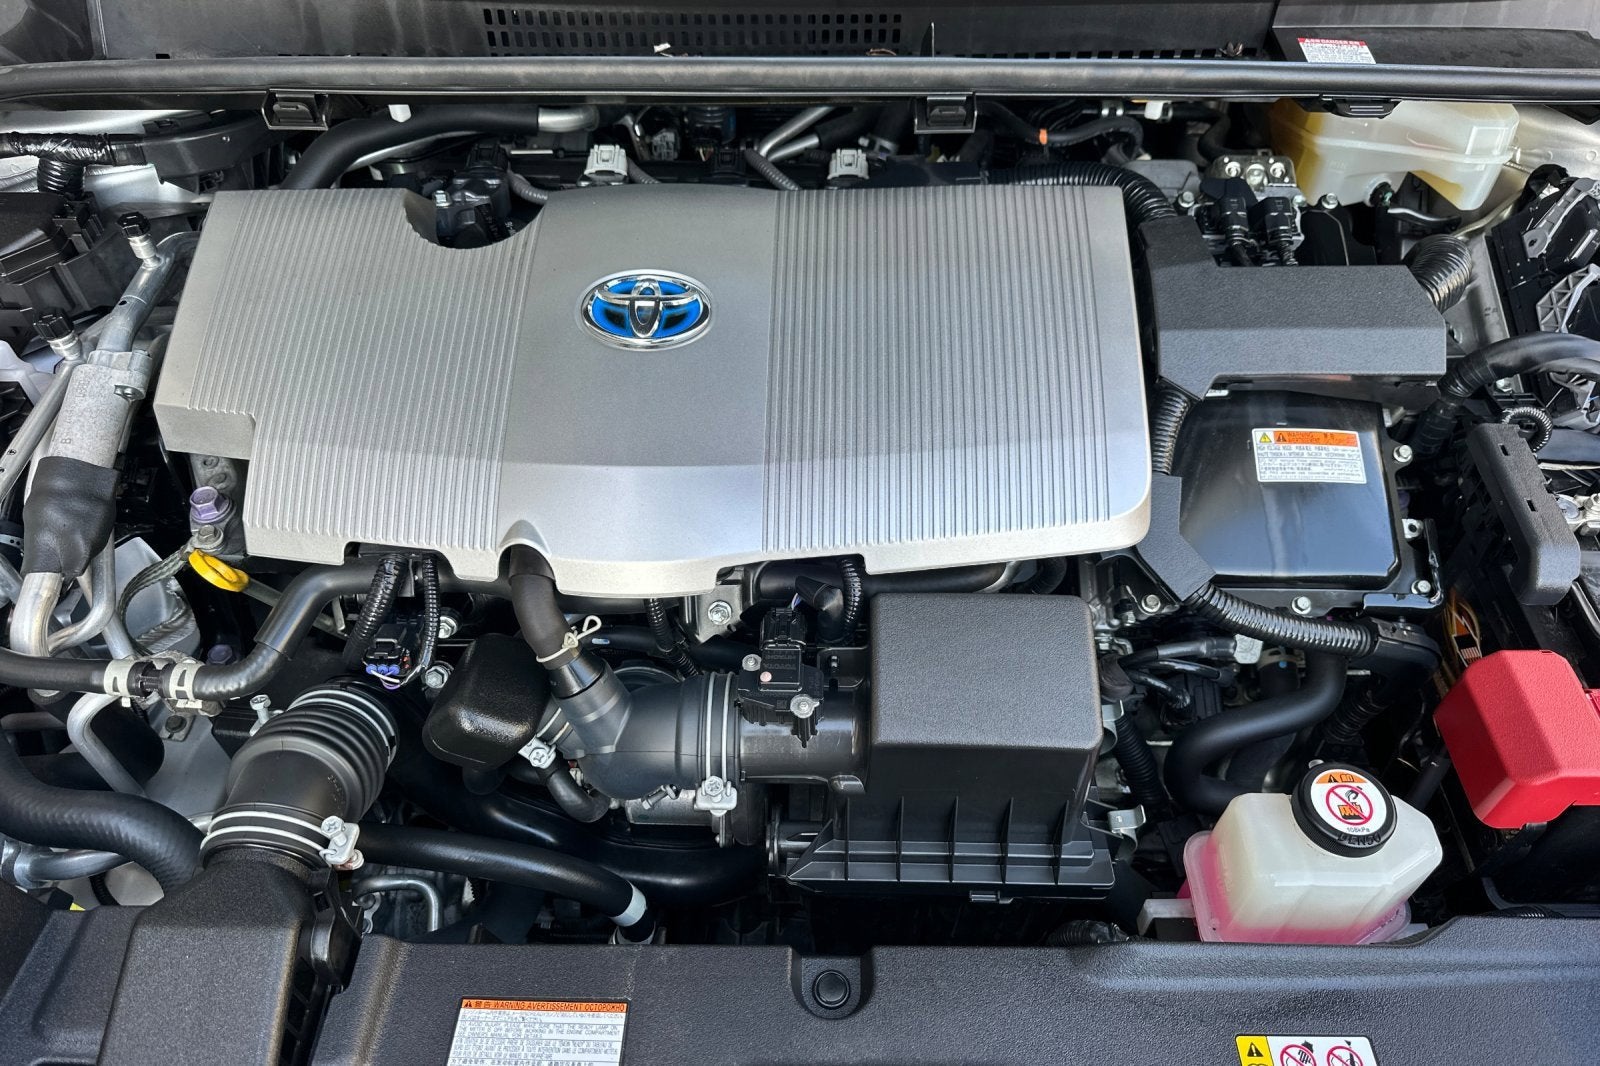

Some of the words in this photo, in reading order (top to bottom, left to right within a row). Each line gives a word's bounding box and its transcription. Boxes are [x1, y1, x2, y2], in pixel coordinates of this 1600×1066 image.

[1337, 832, 1382, 846] DENSO
[494, 1001, 526, 1009] WARNING
[527, 1002, 583, 1011] AVERTISSEMENT
